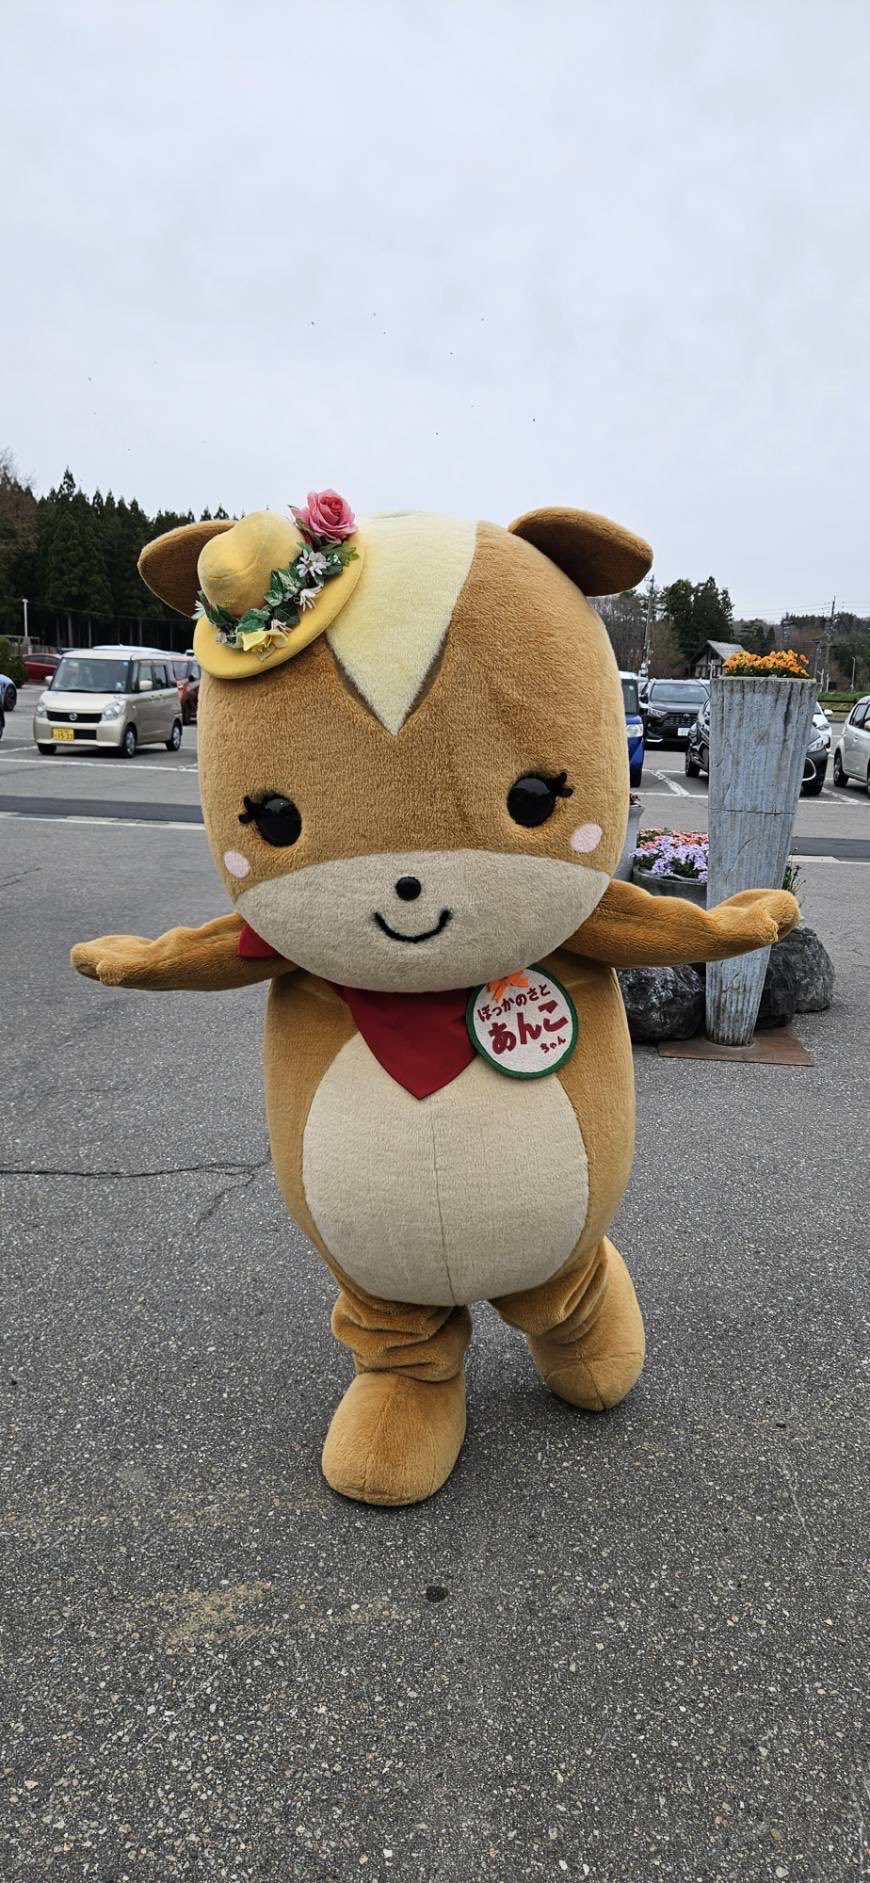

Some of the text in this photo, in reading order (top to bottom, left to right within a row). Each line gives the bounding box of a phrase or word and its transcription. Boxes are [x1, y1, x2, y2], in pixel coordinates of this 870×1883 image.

[477, 984, 551, 1022] ほっかのさと
[488, 1000, 569, 1055] あんこ
[540, 1036, 566, 1053] ちゃん
